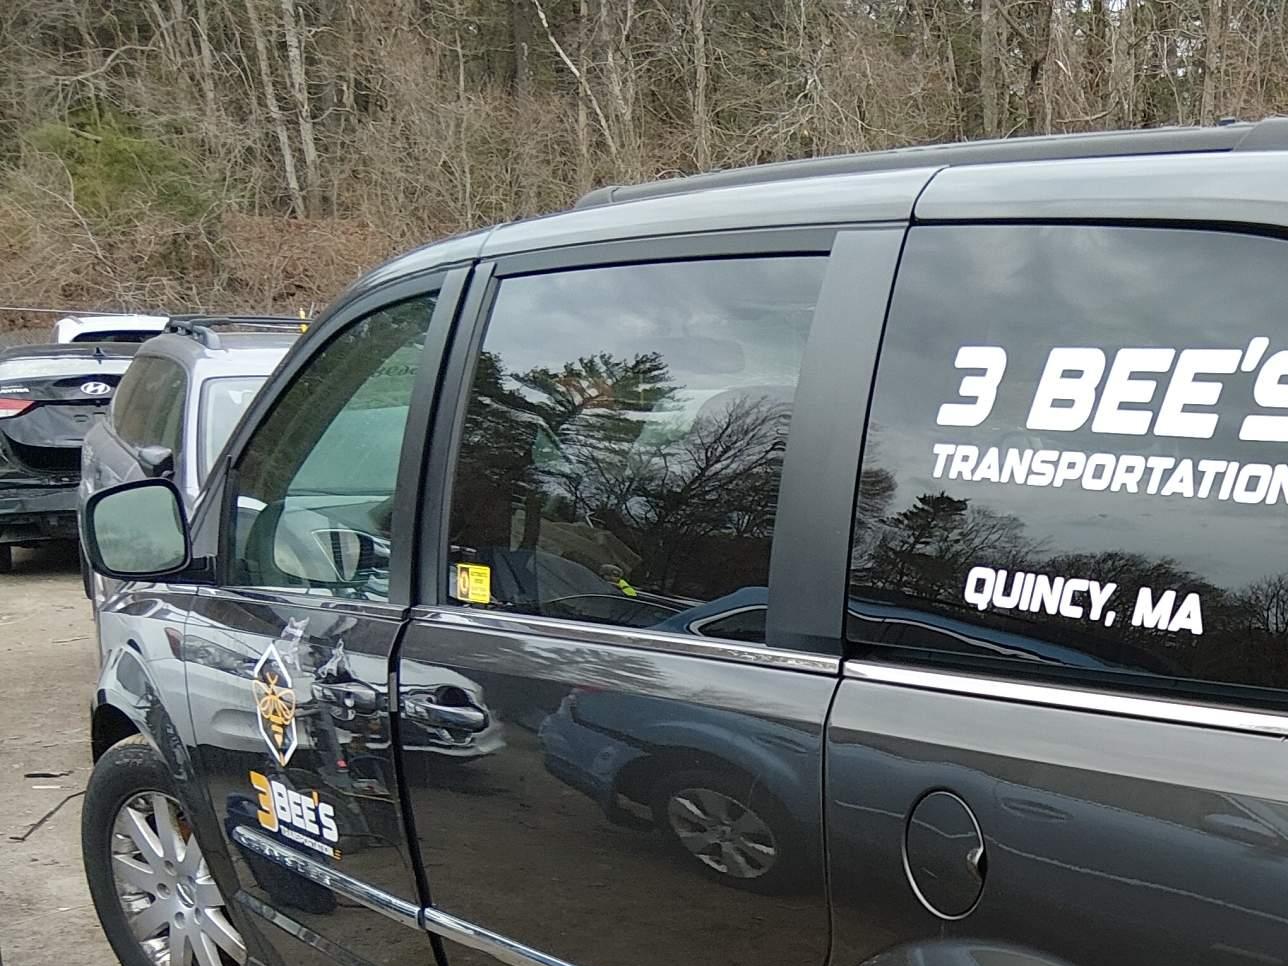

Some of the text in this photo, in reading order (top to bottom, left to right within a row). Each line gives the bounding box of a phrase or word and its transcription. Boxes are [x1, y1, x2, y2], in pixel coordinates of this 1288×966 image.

[936, 346, 1007, 427] 3
[964, 566, 1203, 635] QUINCY, MA
